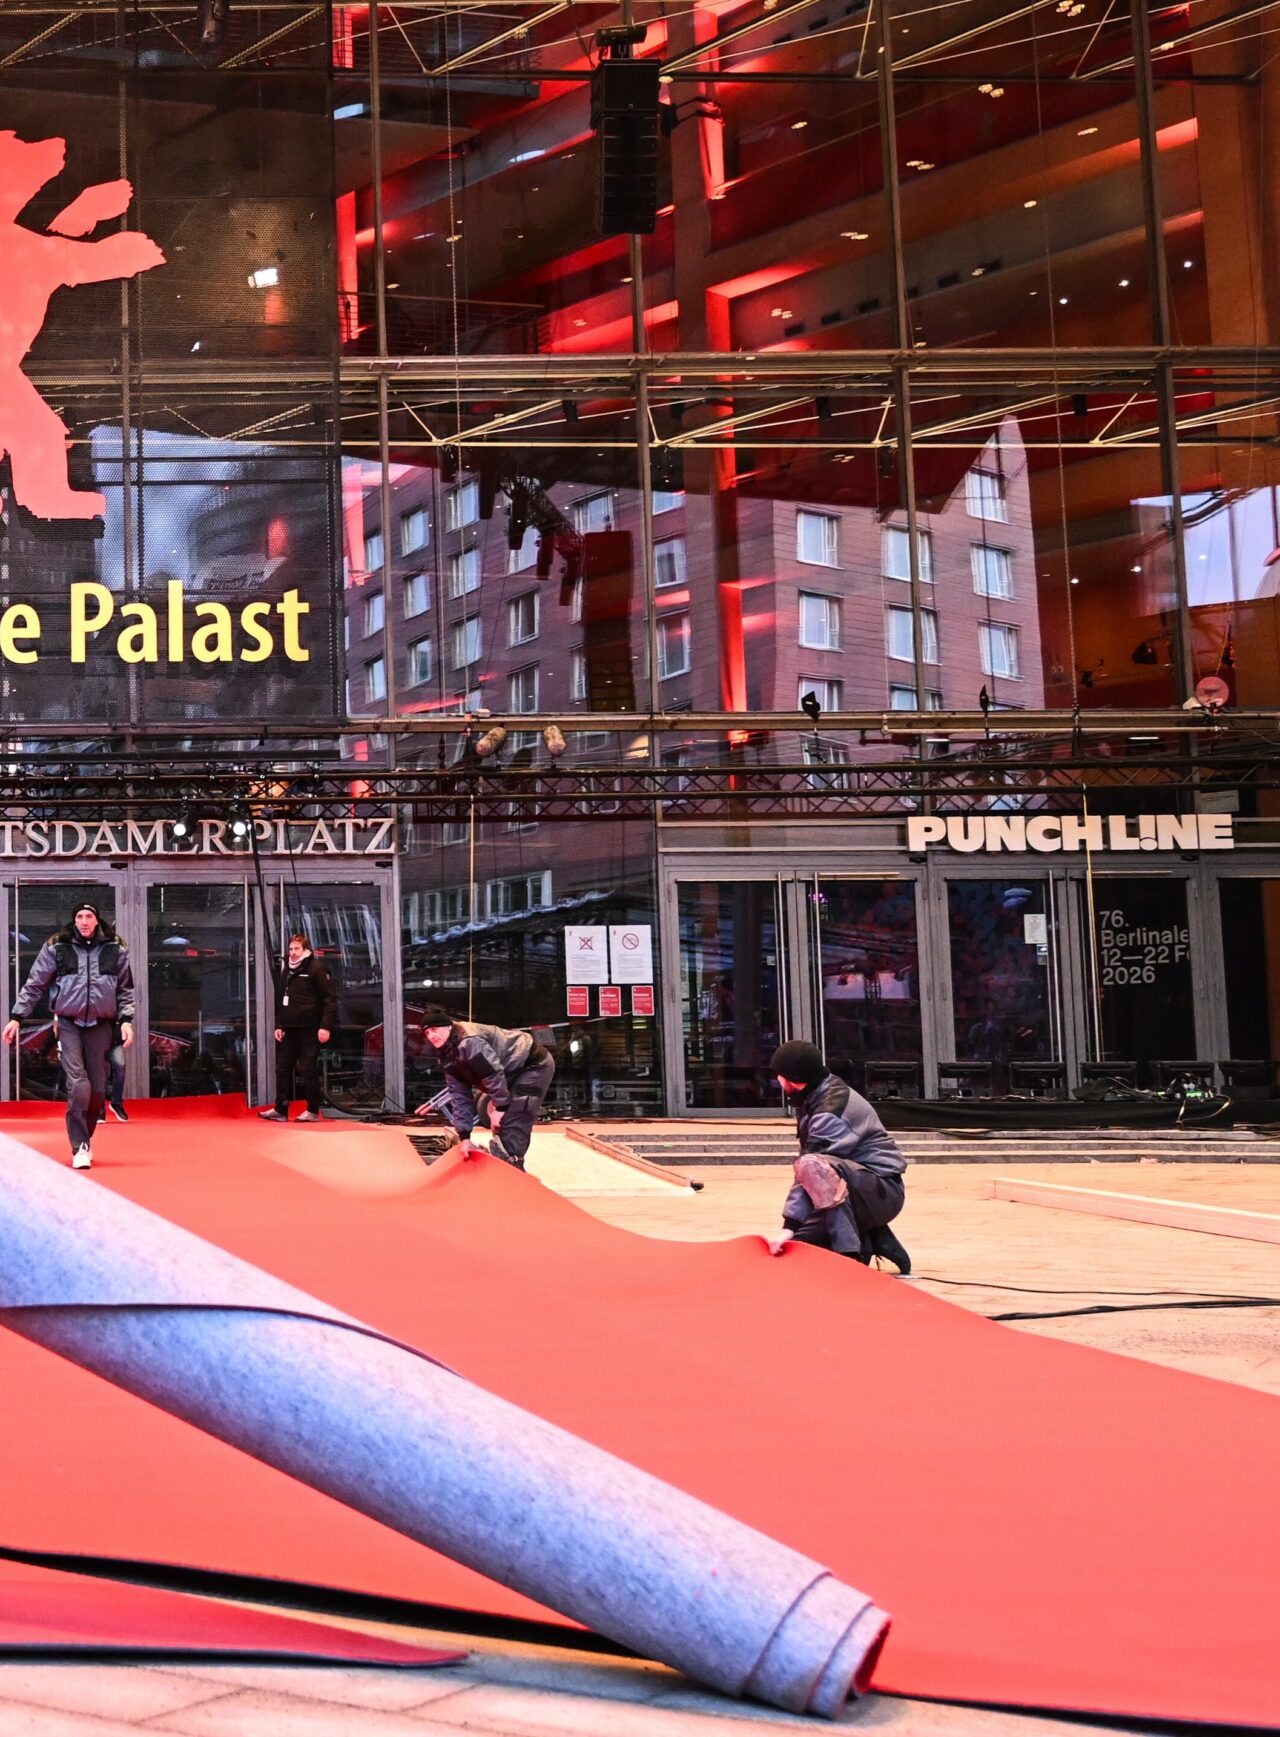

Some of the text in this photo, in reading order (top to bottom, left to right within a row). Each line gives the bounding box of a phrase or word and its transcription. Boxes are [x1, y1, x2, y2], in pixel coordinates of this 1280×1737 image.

[70, 579, 310, 663] Palast
[242, 818, 396, 855] PLATZ
[1099, 909, 1129, 928] 76.
[1100, 924, 1189, 948] Berlinale
[1174, 944, 1191, 963] F
[1102, 965, 1156, 985] 2026
